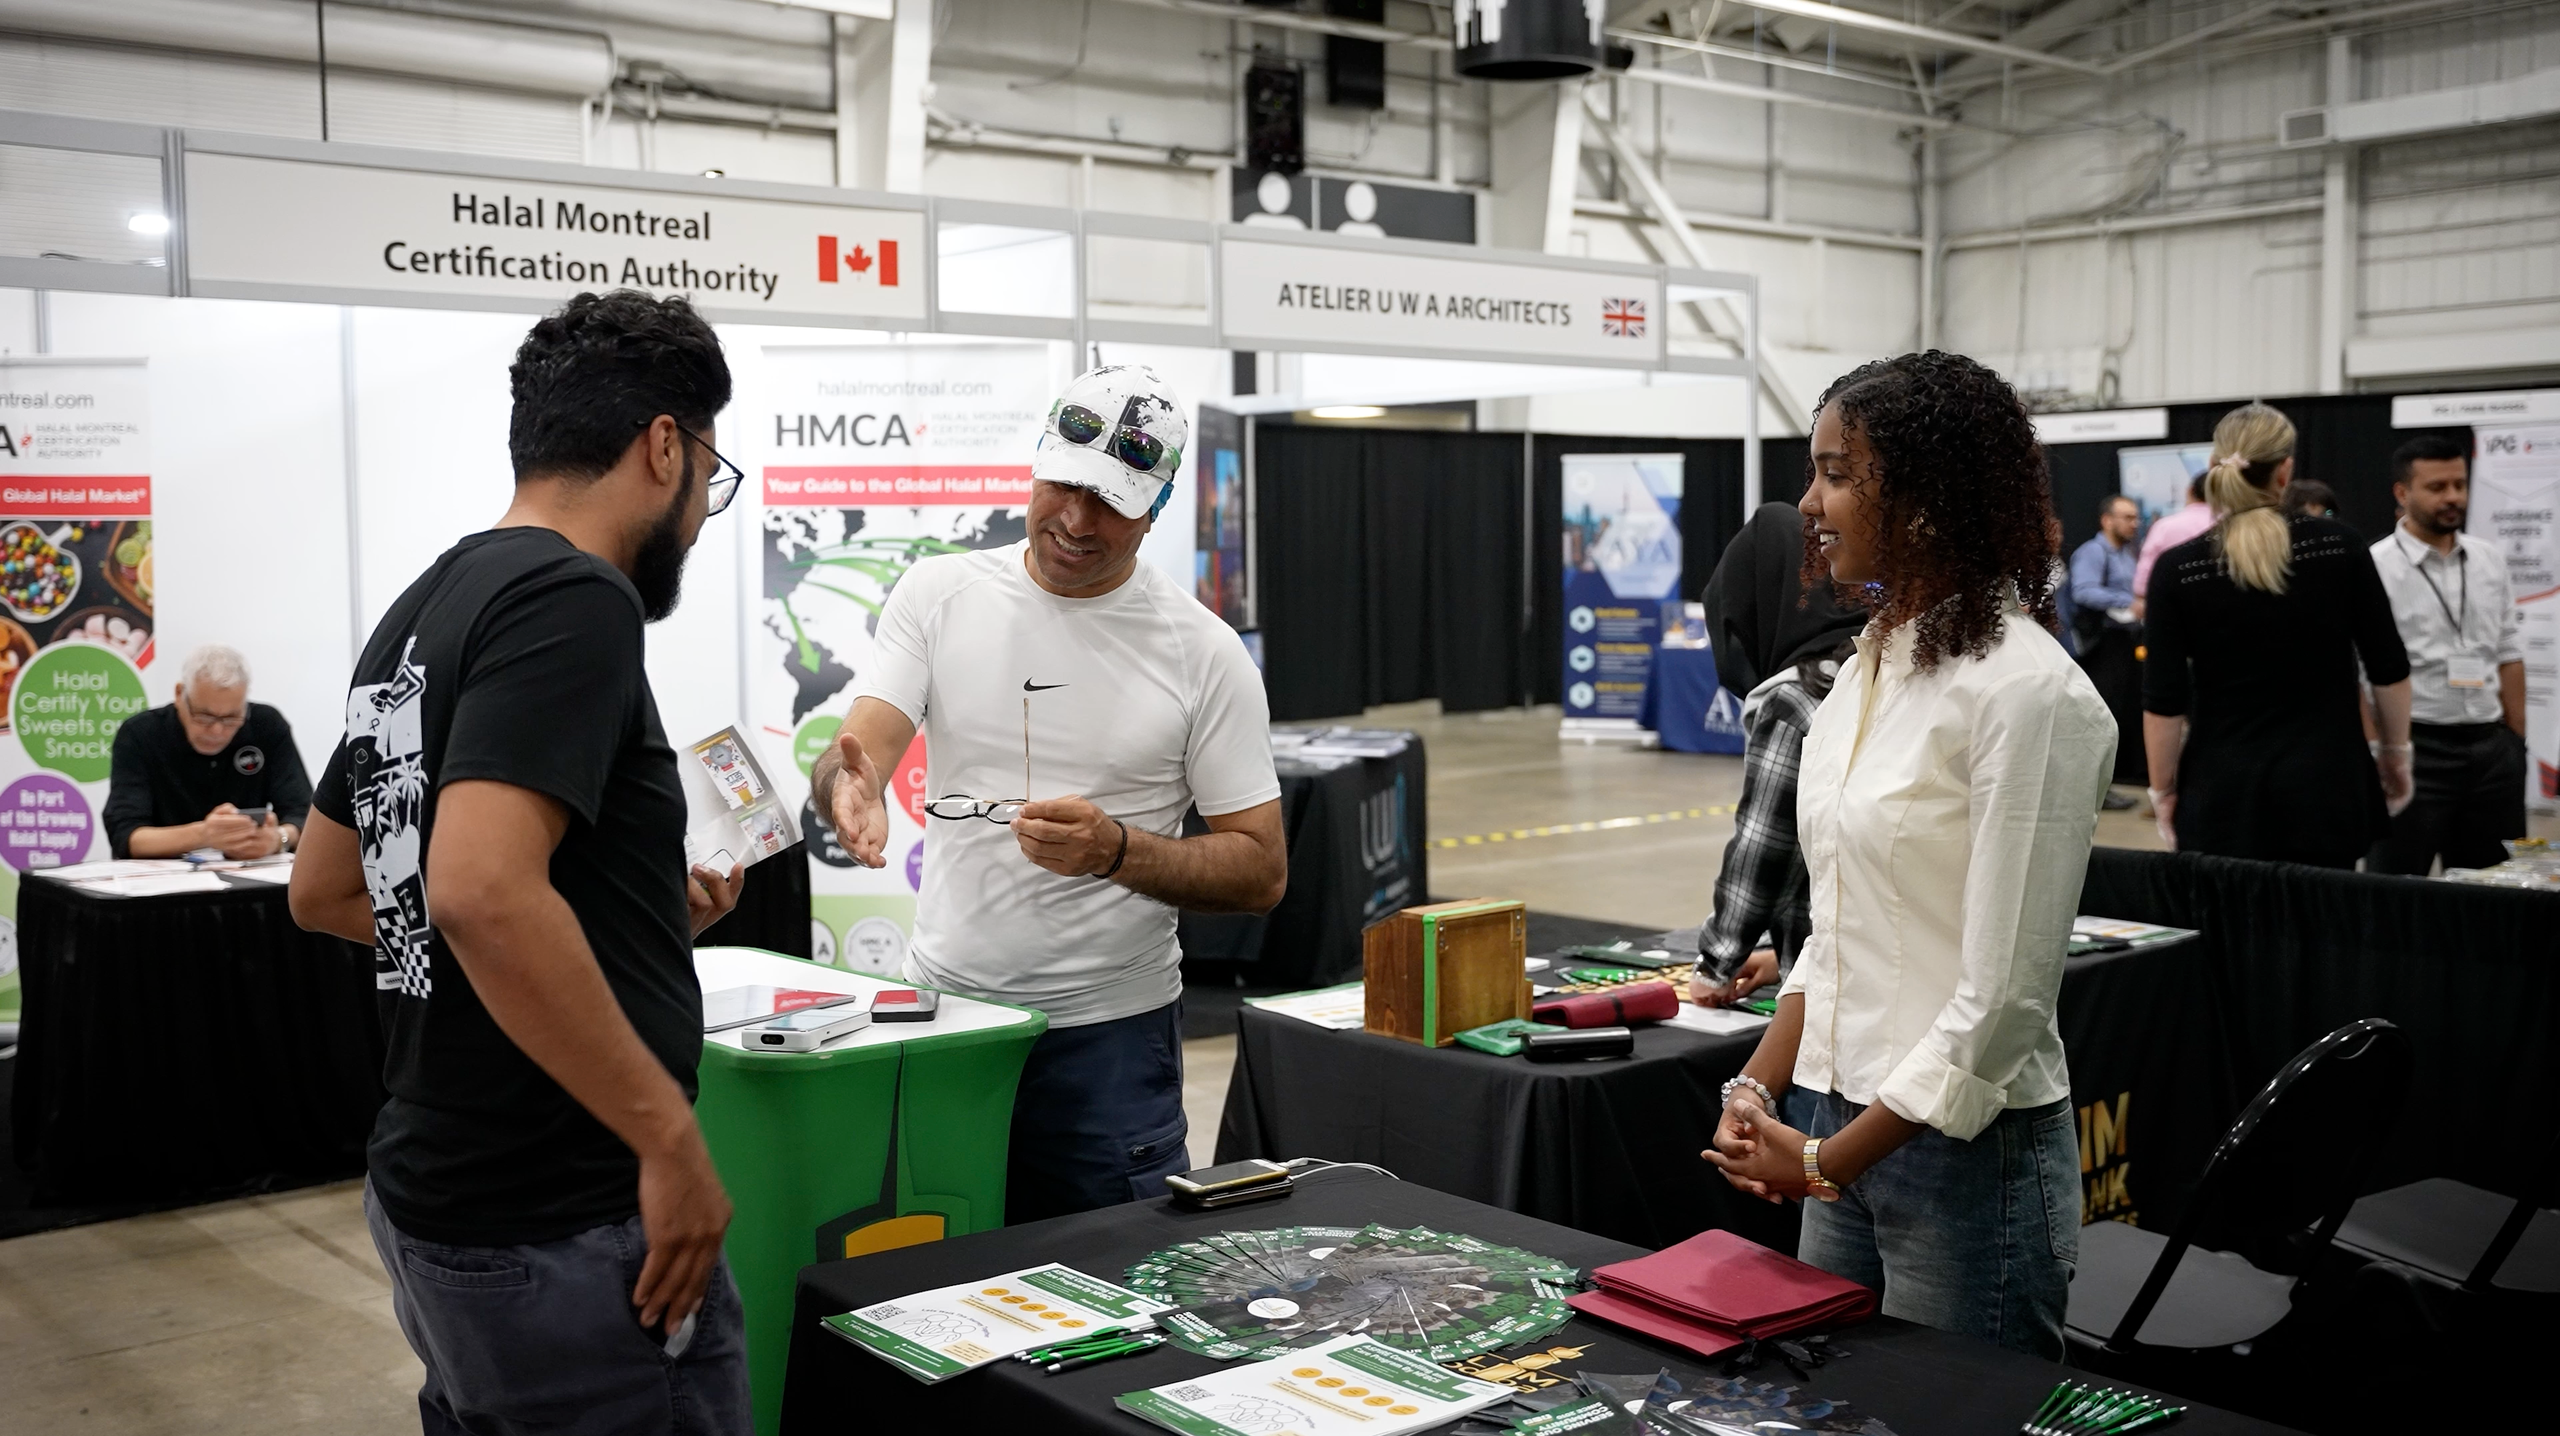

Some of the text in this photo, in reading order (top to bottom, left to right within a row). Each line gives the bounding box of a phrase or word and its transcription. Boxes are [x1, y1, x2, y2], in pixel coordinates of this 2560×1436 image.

[453, 191, 711, 241] Halal Montreal
[384, 241, 779, 302] Certification Authority
[1278, 282, 1571, 328] ATELIER U W A ARCHITECTS
[818, 380, 992, 397] halalmontreal.com
[0, 392, 94, 409] ntreal.com
[775, 414, 911, 447] HMCA
[931, 424, 1018, 435] CERTIFICATION
[36, 435, 120, 447] CERTIFICATION
[931, 437, 999, 447] AUTHORITY
[36, 448, 103, 460] AUTHORITY
[767, 478, 802, 493] Your
[804, 477, 848, 493] Guide
[850, 479, 864, 493] to
[868, 478, 893, 493] the
[895, 477, 942, 493] Global
[944, 477, 982, 493] Halal
[3, 488, 48, 504] Global
[50, 488, 86, 504] Halal
[53, 670, 109, 690] Halal
[20, 692, 145, 716] Certify Your
[20, 715, 95, 736] Sweets
[45, 738, 112, 758] Snack
[20, 790, 65, 806] Be Part
[0, 809, 87, 831] of the Growing
[9, 831, 79, 849] Halal Supply
[28, 850, 61, 867] Chain
[1058, 1278, 1080, 1288] Program
[1362, 1345, 1391, 1357] ASPIRE
[1370, 1354, 1403, 1368] Program
[1576, 1402, 1602, 1413] SINCE
[1535, 1411, 1614, 1436] SERVING OUR
[1539, 1406, 1608, 1431] COMMUNITY
